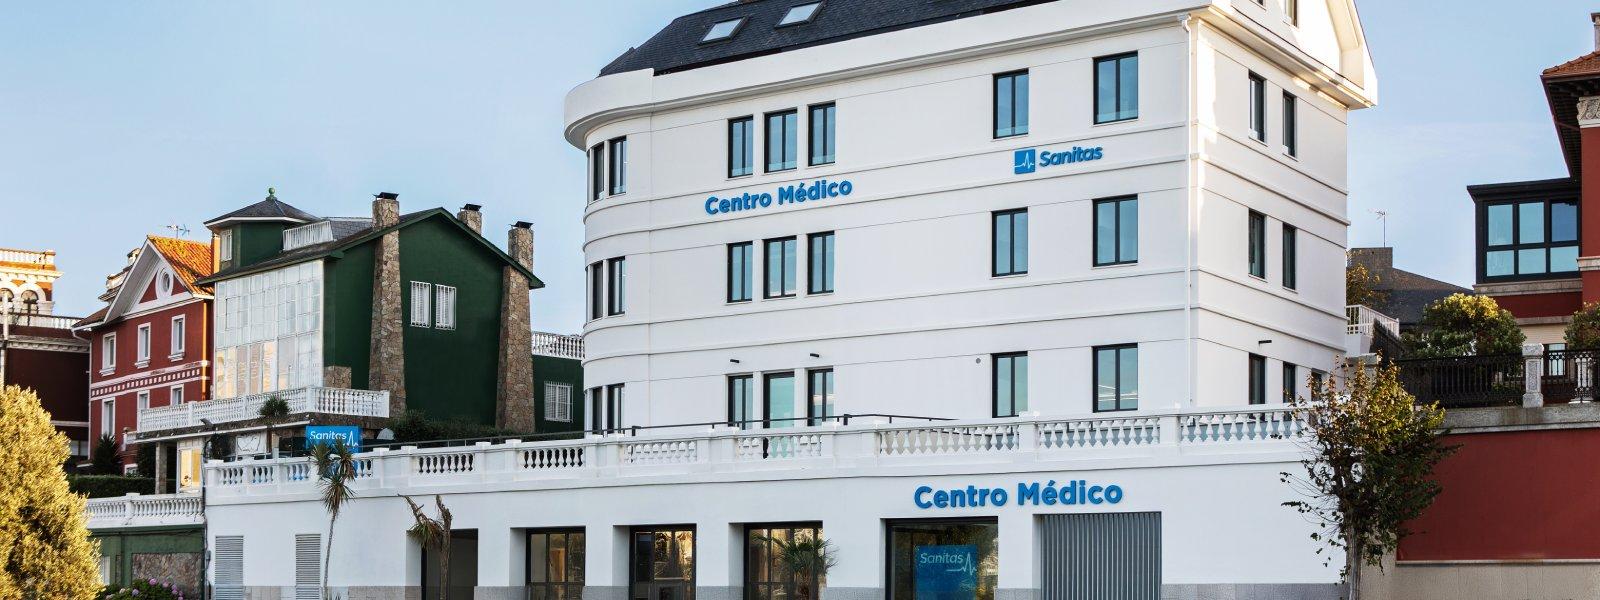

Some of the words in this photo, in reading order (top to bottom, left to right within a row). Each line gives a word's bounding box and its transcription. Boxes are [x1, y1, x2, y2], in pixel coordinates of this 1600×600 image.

[1039, 146, 1103, 167] Sanitas
[705, 191, 772, 215] Centro
[777, 179, 853, 206] Médico
[310, 430, 347, 440] Sanitas
[913, 484, 1008, 509] Centro
[1017, 479, 1123, 506] Médico
[920, 552, 964, 564] Sanitas
